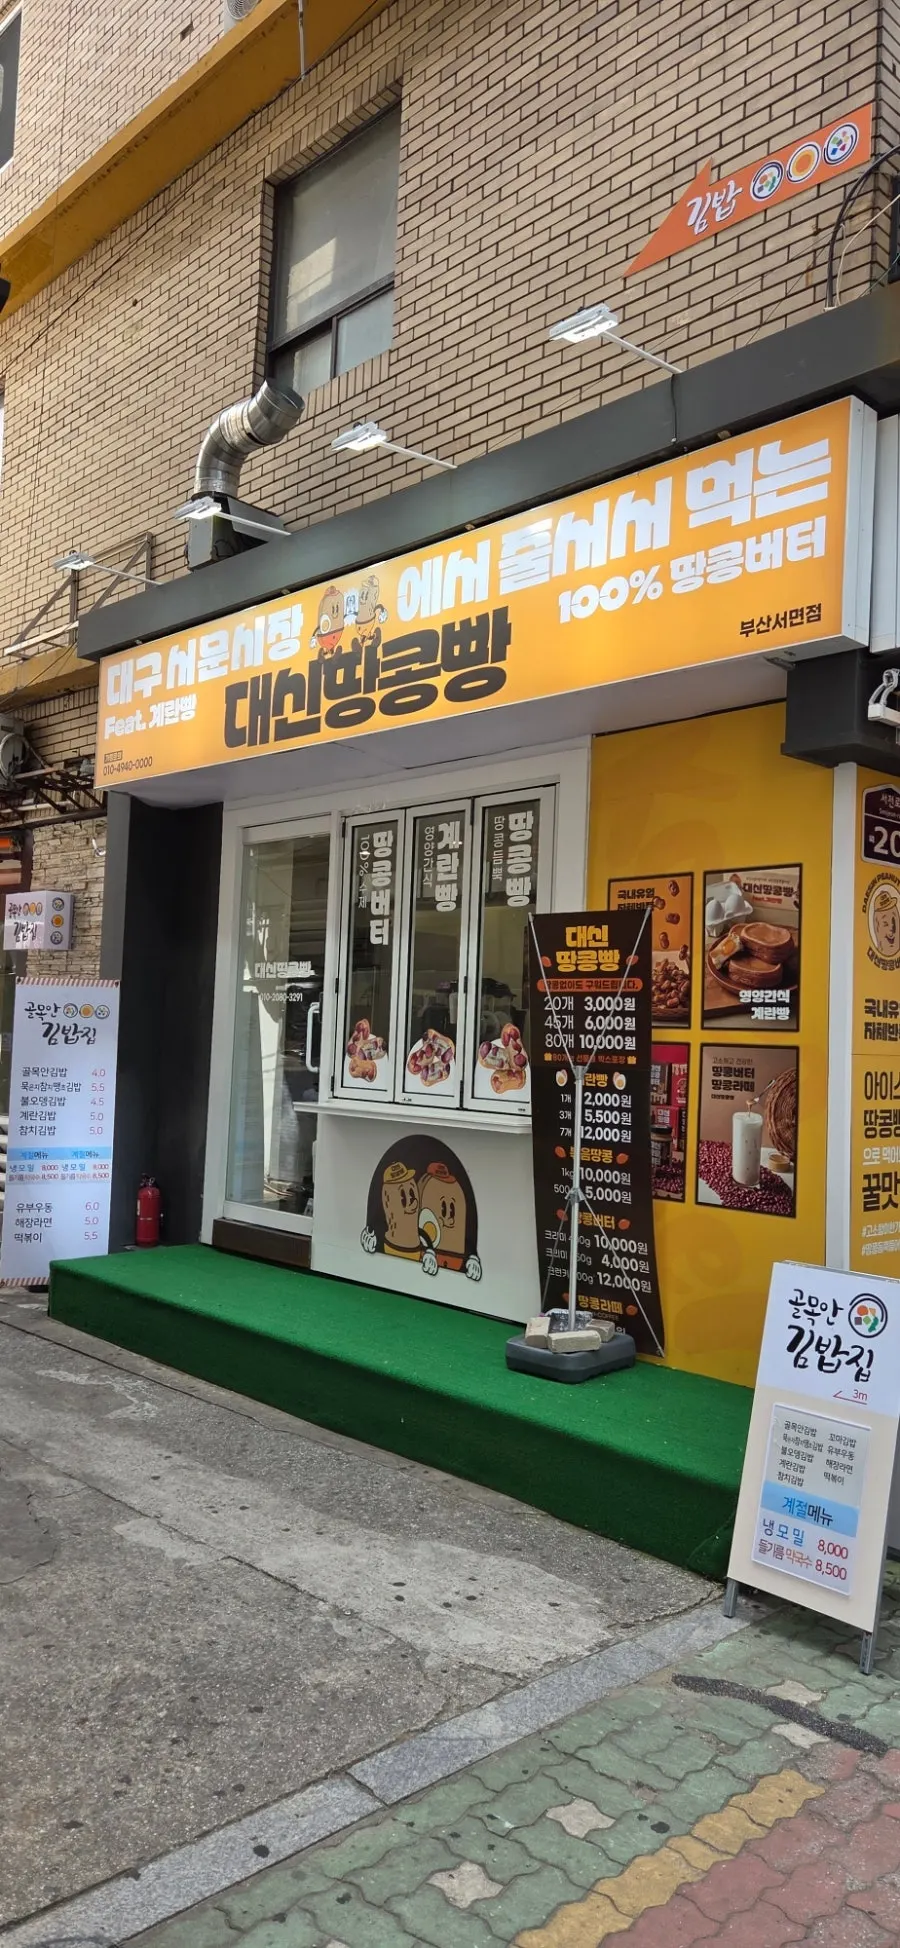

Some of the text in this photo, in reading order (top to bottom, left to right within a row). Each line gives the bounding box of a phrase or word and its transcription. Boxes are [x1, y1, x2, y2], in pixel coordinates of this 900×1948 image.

[687, 180, 743, 235] 김밥
[107, 438, 832, 706] 대구 서문시장 에서 줄서서 먹는
[558, 515, 826, 623] 100% 땅콩버터
[739, 603, 822, 637] 부산서면점
[224, 605, 512, 748] 대신땅콩빵
[104, 693, 197, 740] Feat. 계란빵
[103, 756, 153, 776] 010-4940-0000
[423, 826, 435, 887] 영양간식
[492, 815, 505, 881] 땅콩듬뿍
[435, 821, 460, 912] 계란빵
[506, 810, 534, 907] 땅콩빵
[358, 883, 368, 909] 수제
[370, 830, 393, 945] 땅콩버터
[565, 925, 609, 947] 대신
[556, 949, 620, 972] 땅콩빵
[544, 996, 636, 1011] 20개 3,000원
[739, 989, 790, 1003] 영양간식
[24, 1001, 61, 1022] 골목안
[751, 1006, 790, 1021] 계란빵
[544, 1015, 636, 1030] 45개 6,000원
[41, 1022, 97, 1045] 김밥집
[545, 1033, 637, 1050] 80개 10,000원
[22, 1066, 106, 1077] 골목안김밥 4.0
[582, 1072, 608, 1087] 란빵
[712, 1066, 755, 1079] 땅콩버터
[91, 1082, 105, 1092] 5.5
[711, 1079, 755, 1092] 땅콩라떼
[90, 1097, 104, 1106] 4.5
[561, 1091, 631, 1108] 1개 2,000원
[20, 1110, 104, 1121] 계란김밥 5.0
[559, 1108, 631, 1126] 3개 5,500원
[19, 1125, 104, 1136] 참치김밥 5.0
[560, 1126, 631, 1143] 7개 12,000원
[580, 1167, 631, 1186] 10,000원
[585, 1186, 631, 1204] 5,000원
[16, 1202, 100, 1213] 유부우동 6.0
[15, 1216, 99, 1228] 해장라면 5.0
[14, 1231, 98, 1243] 떡볶이 5.5
[594, 1235, 648, 1255] 10,000원
[602, 1254, 650, 1273] 4,000원
[597, 1272, 652, 1293] 12,000원
[578, 1295, 623, 1314] 땅콩라떼
[788, 1288, 844, 1326] 골목안
[786, 1325, 874, 1382] 김밥집
[853, 1389, 867, 1401] 3m
[784, 1420, 857, 1448] 골목안김밥 꼬마김밥
[827, 1445, 855, 1461] 유부우동
[779, 1459, 844, 1486] 계란김밥 떡볶이
[825, 1459, 853, 1474] 해장라면
[778, 1471, 804, 1487] 참치김밥
[782, 1496, 833, 1527] 계절메뉴
[817, 1539, 848, 1559] 8,000
[815, 1559, 847, 1580] 8,500
